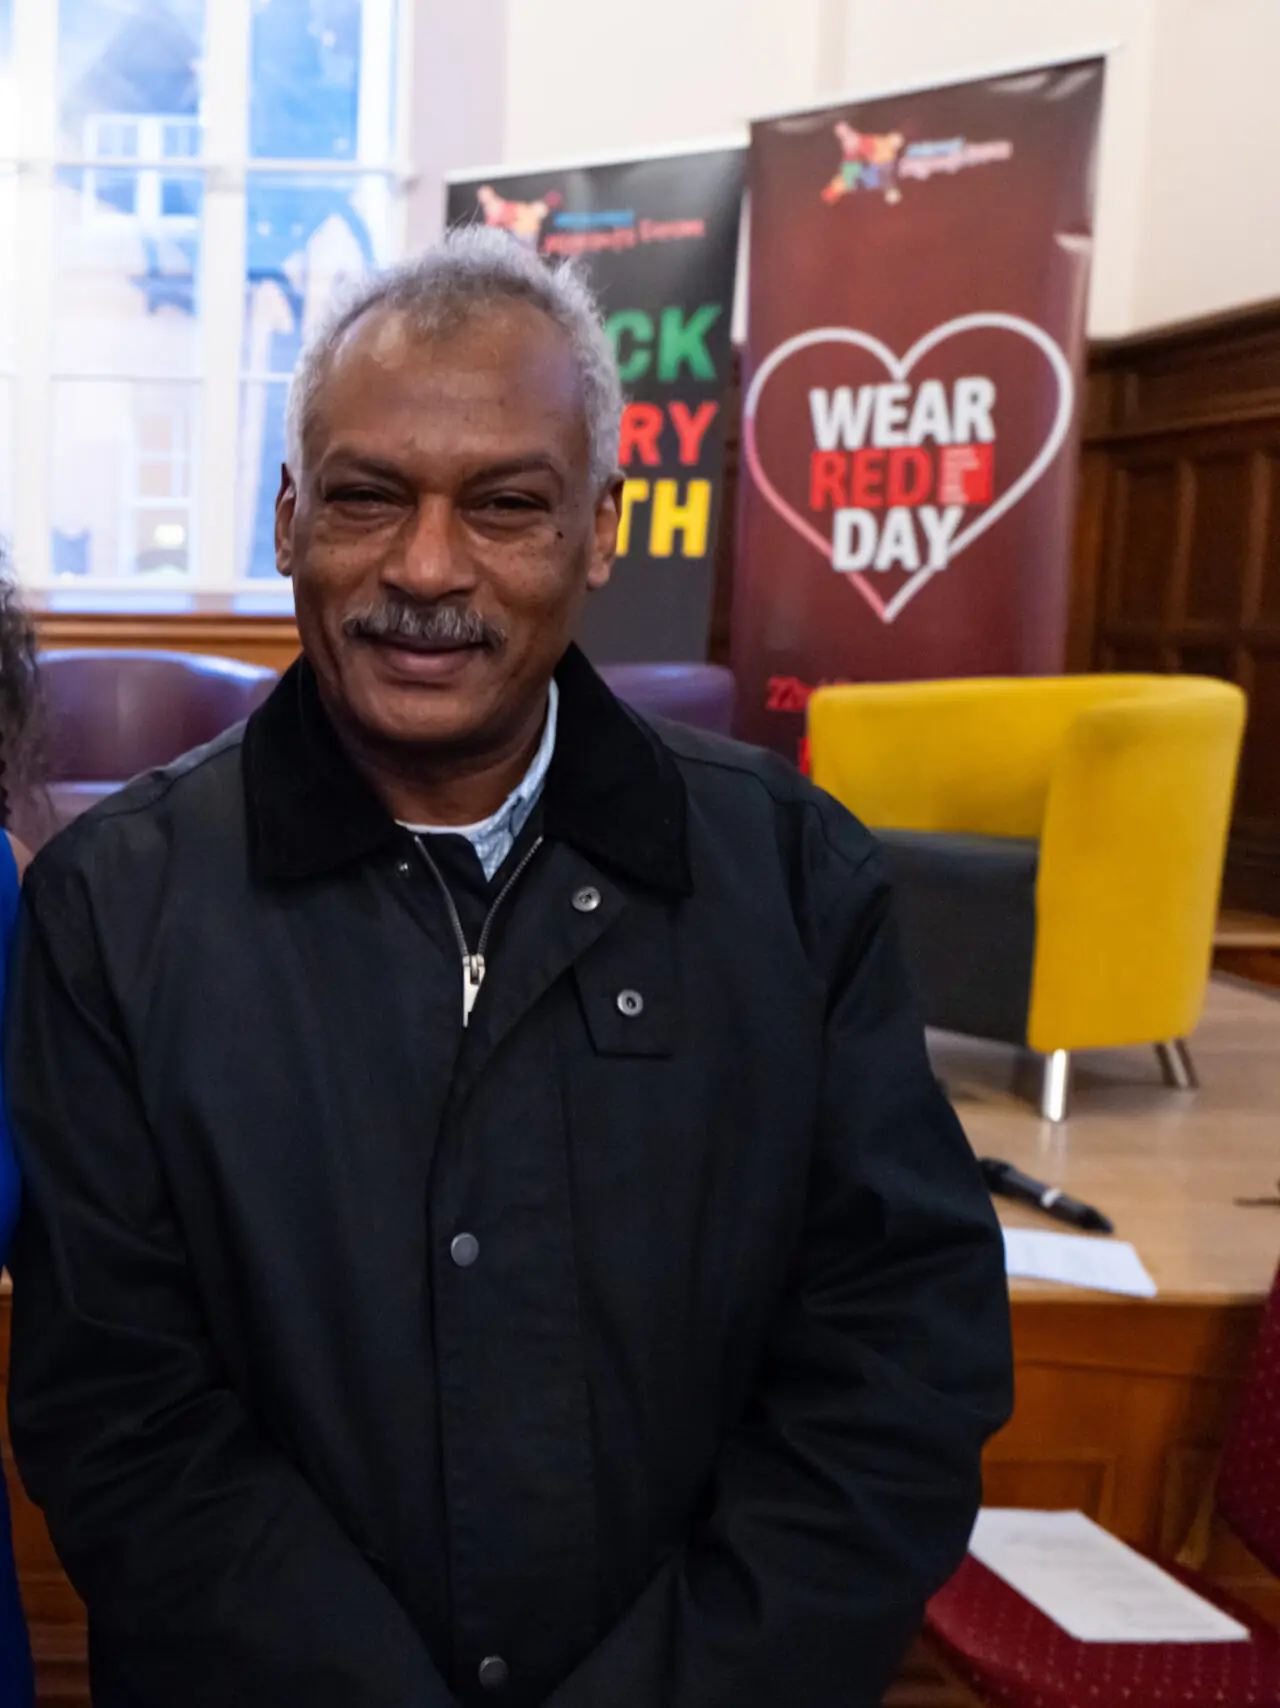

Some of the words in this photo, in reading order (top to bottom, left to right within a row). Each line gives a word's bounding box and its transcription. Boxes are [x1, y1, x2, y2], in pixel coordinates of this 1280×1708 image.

[809, 376, 996, 450] WEAR
[809, 446, 933, 511] RED
[831, 504, 965, 573] DAY
